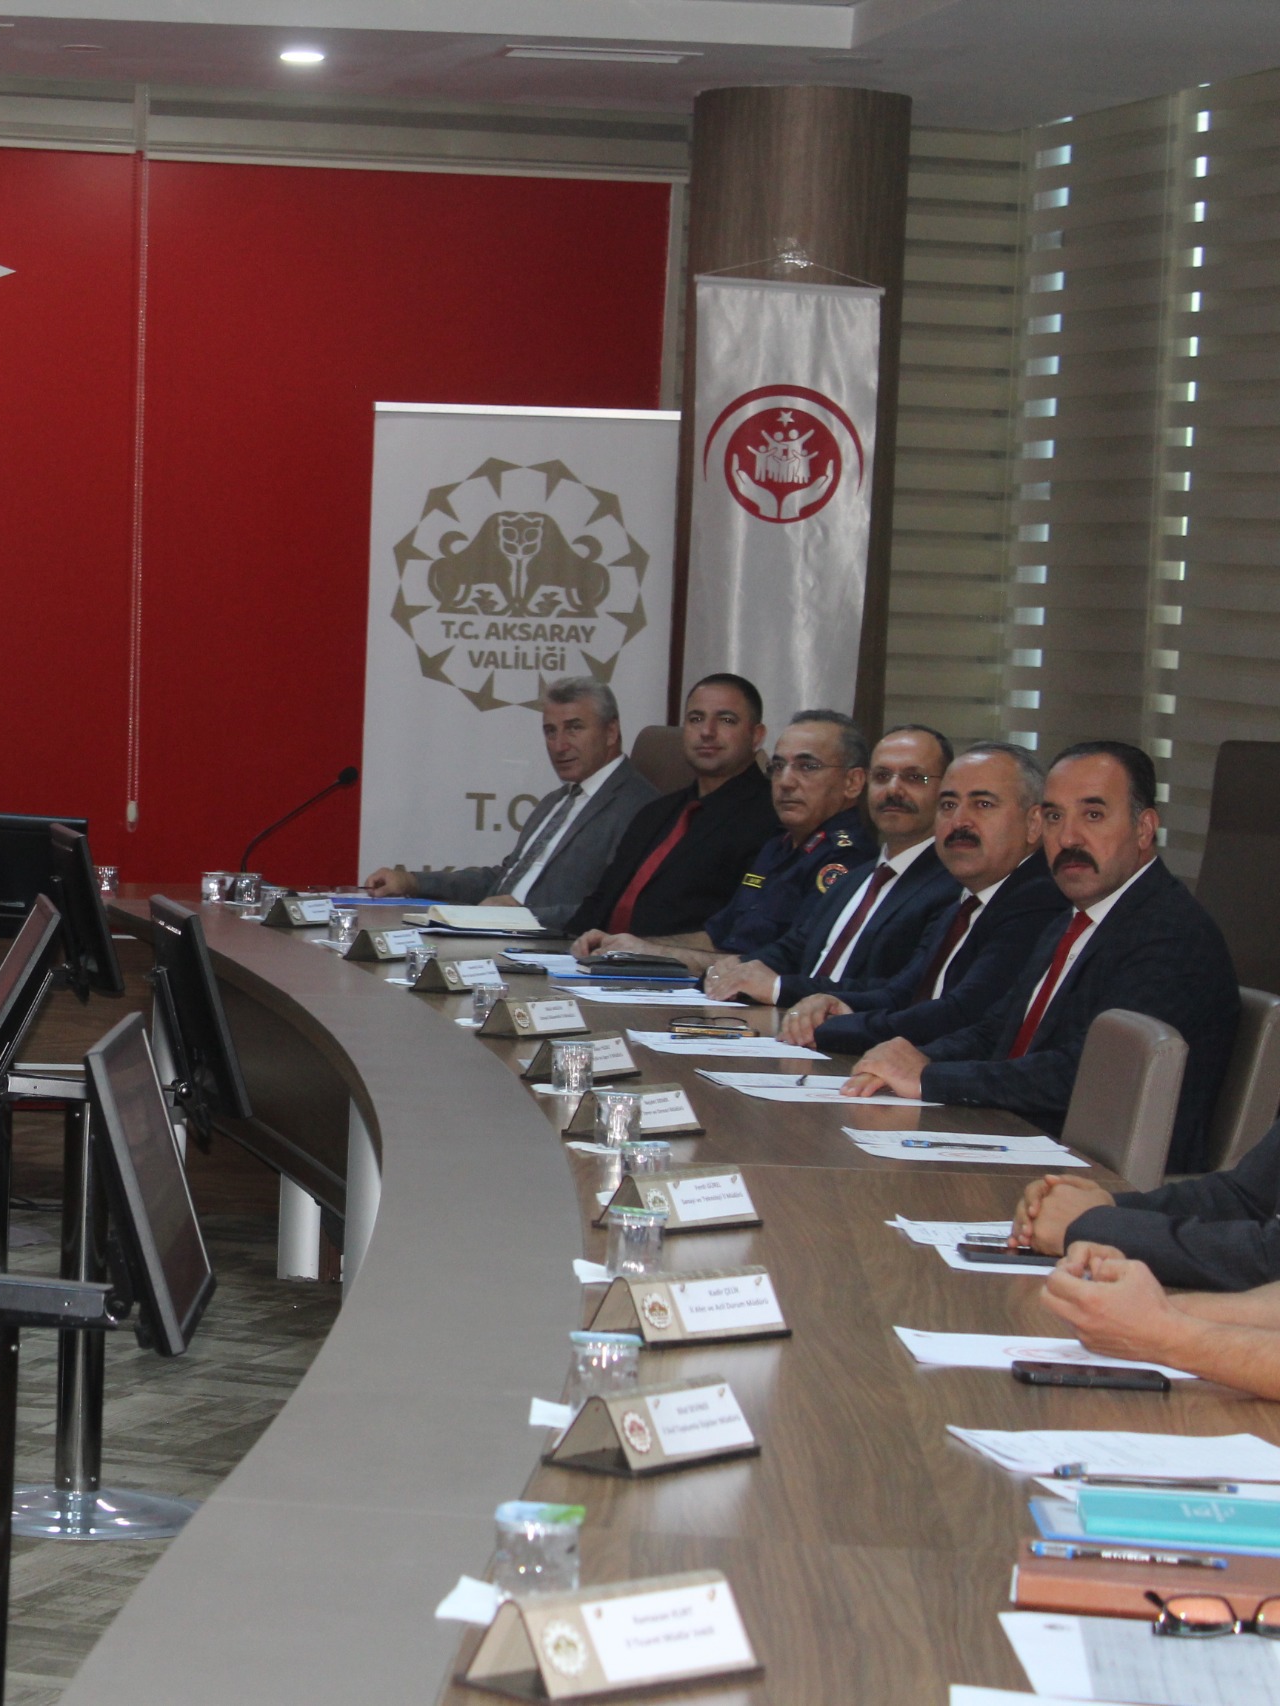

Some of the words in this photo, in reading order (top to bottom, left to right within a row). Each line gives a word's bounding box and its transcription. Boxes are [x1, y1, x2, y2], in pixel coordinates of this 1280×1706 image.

[441, 621, 478, 639] T.C.
[485, 622, 596, 643] AKSARAY
[468, 646, 566, 671] VALİLİĞİ
